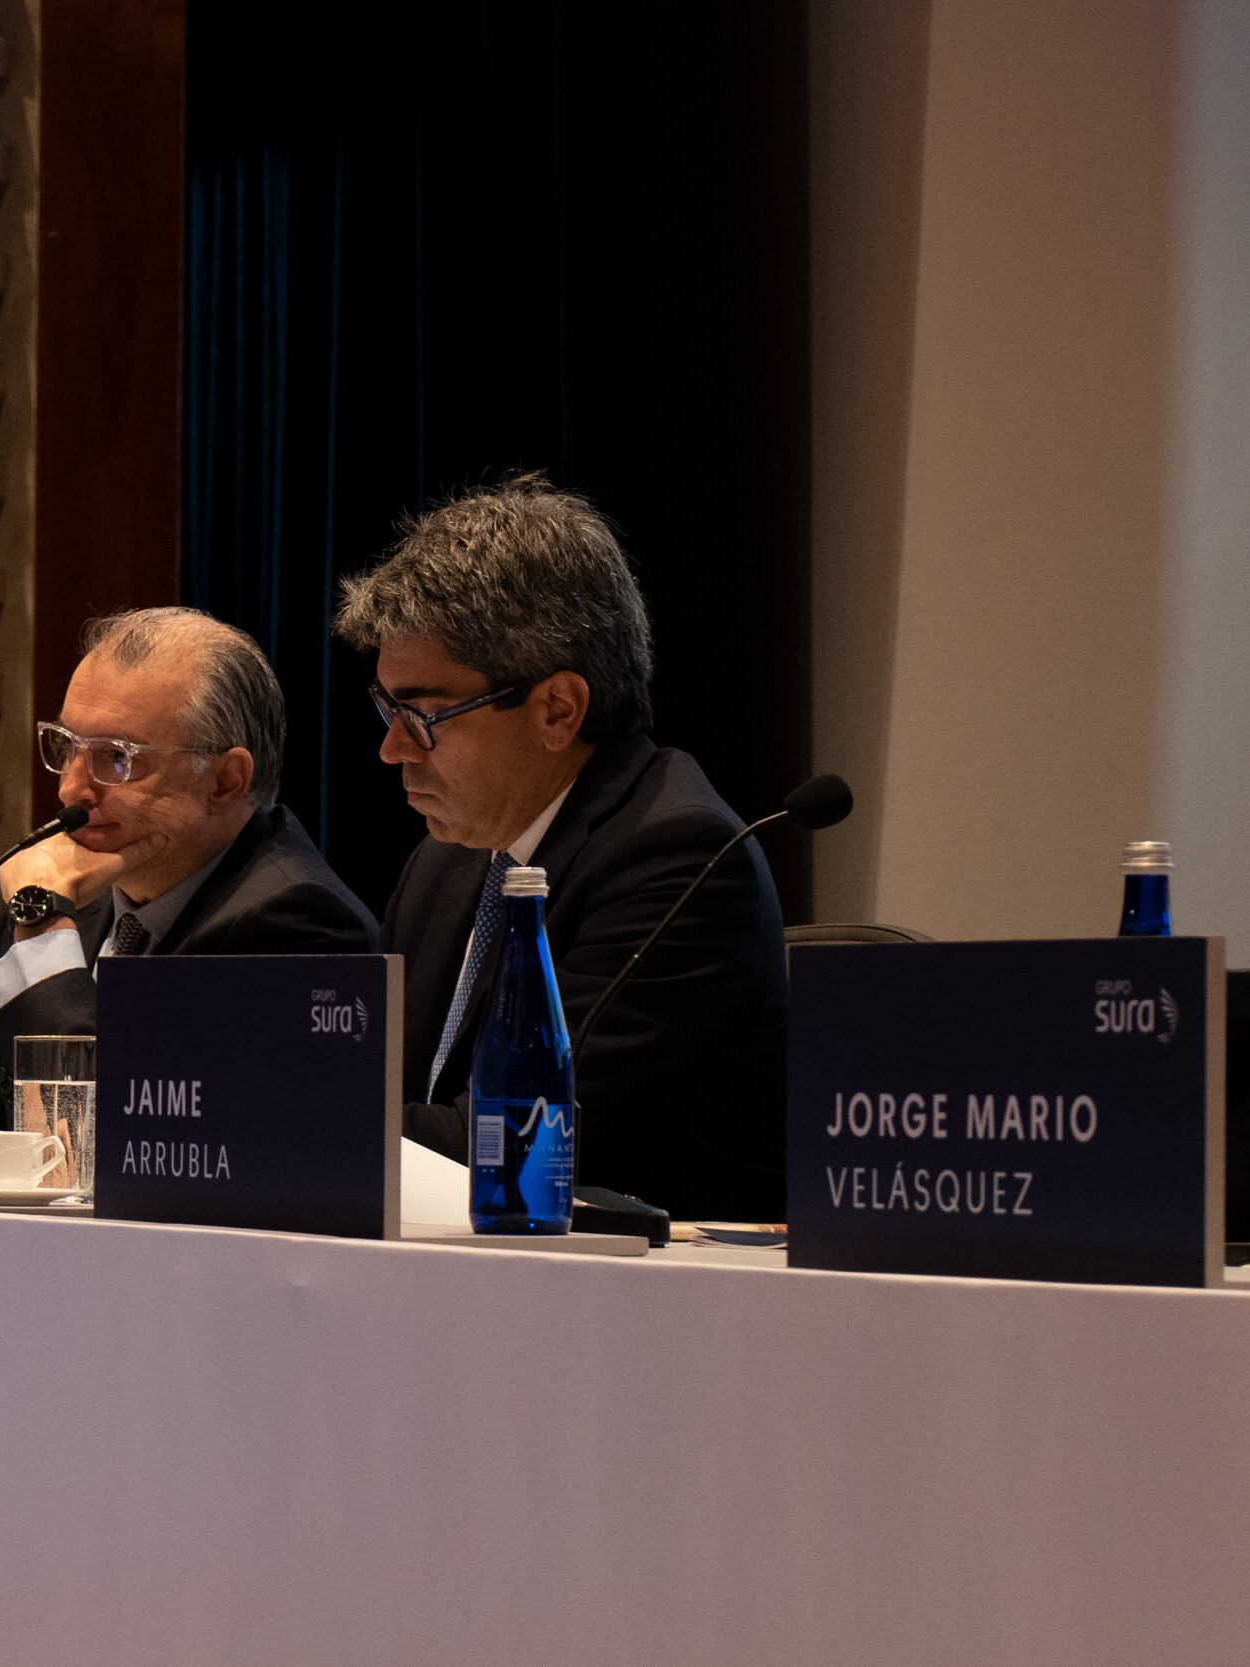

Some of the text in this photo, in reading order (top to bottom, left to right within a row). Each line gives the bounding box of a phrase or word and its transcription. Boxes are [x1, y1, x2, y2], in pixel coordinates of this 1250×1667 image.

[311, 988, 336, 1001] GRUPO
[311, 1005, 352, 1033] sura
[1095, 999, 1154, 1033] sura
[123, 1078, 202, 1118] JAIME
[826, 1092, 1098, 1142] JORGE MARIO
[121, 1140, 231, 1180] ARRUBLA
[826, 1161, 1034, 1216] VELÁSQUEZ
